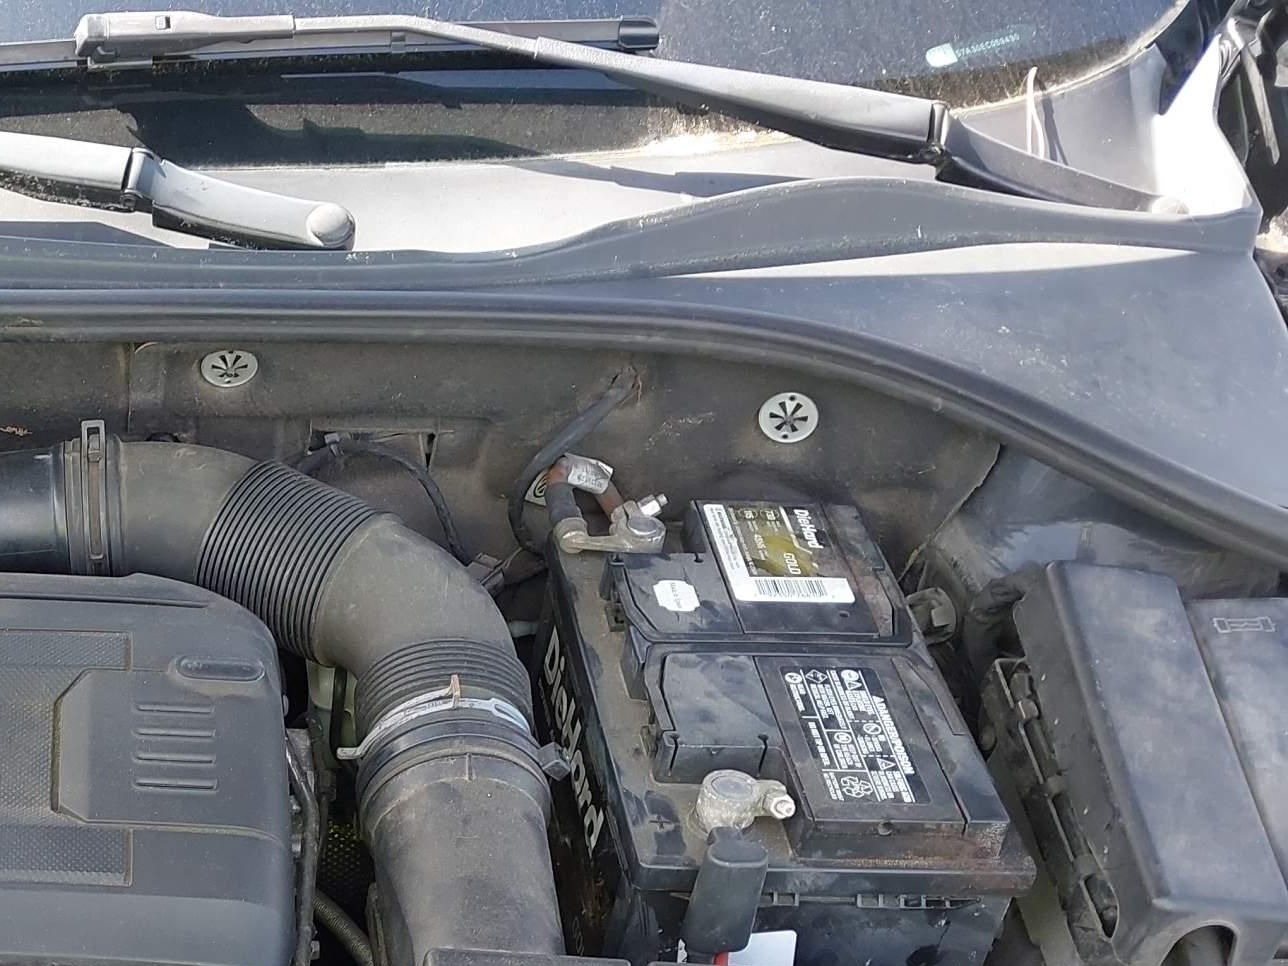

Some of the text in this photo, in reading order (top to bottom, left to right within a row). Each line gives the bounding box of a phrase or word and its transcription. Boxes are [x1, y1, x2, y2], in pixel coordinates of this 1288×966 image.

[794, 509, 824, 549] DieHard
[784, 553, 801, 574] GOLD
[544, 625, 604, 858] DieHard
